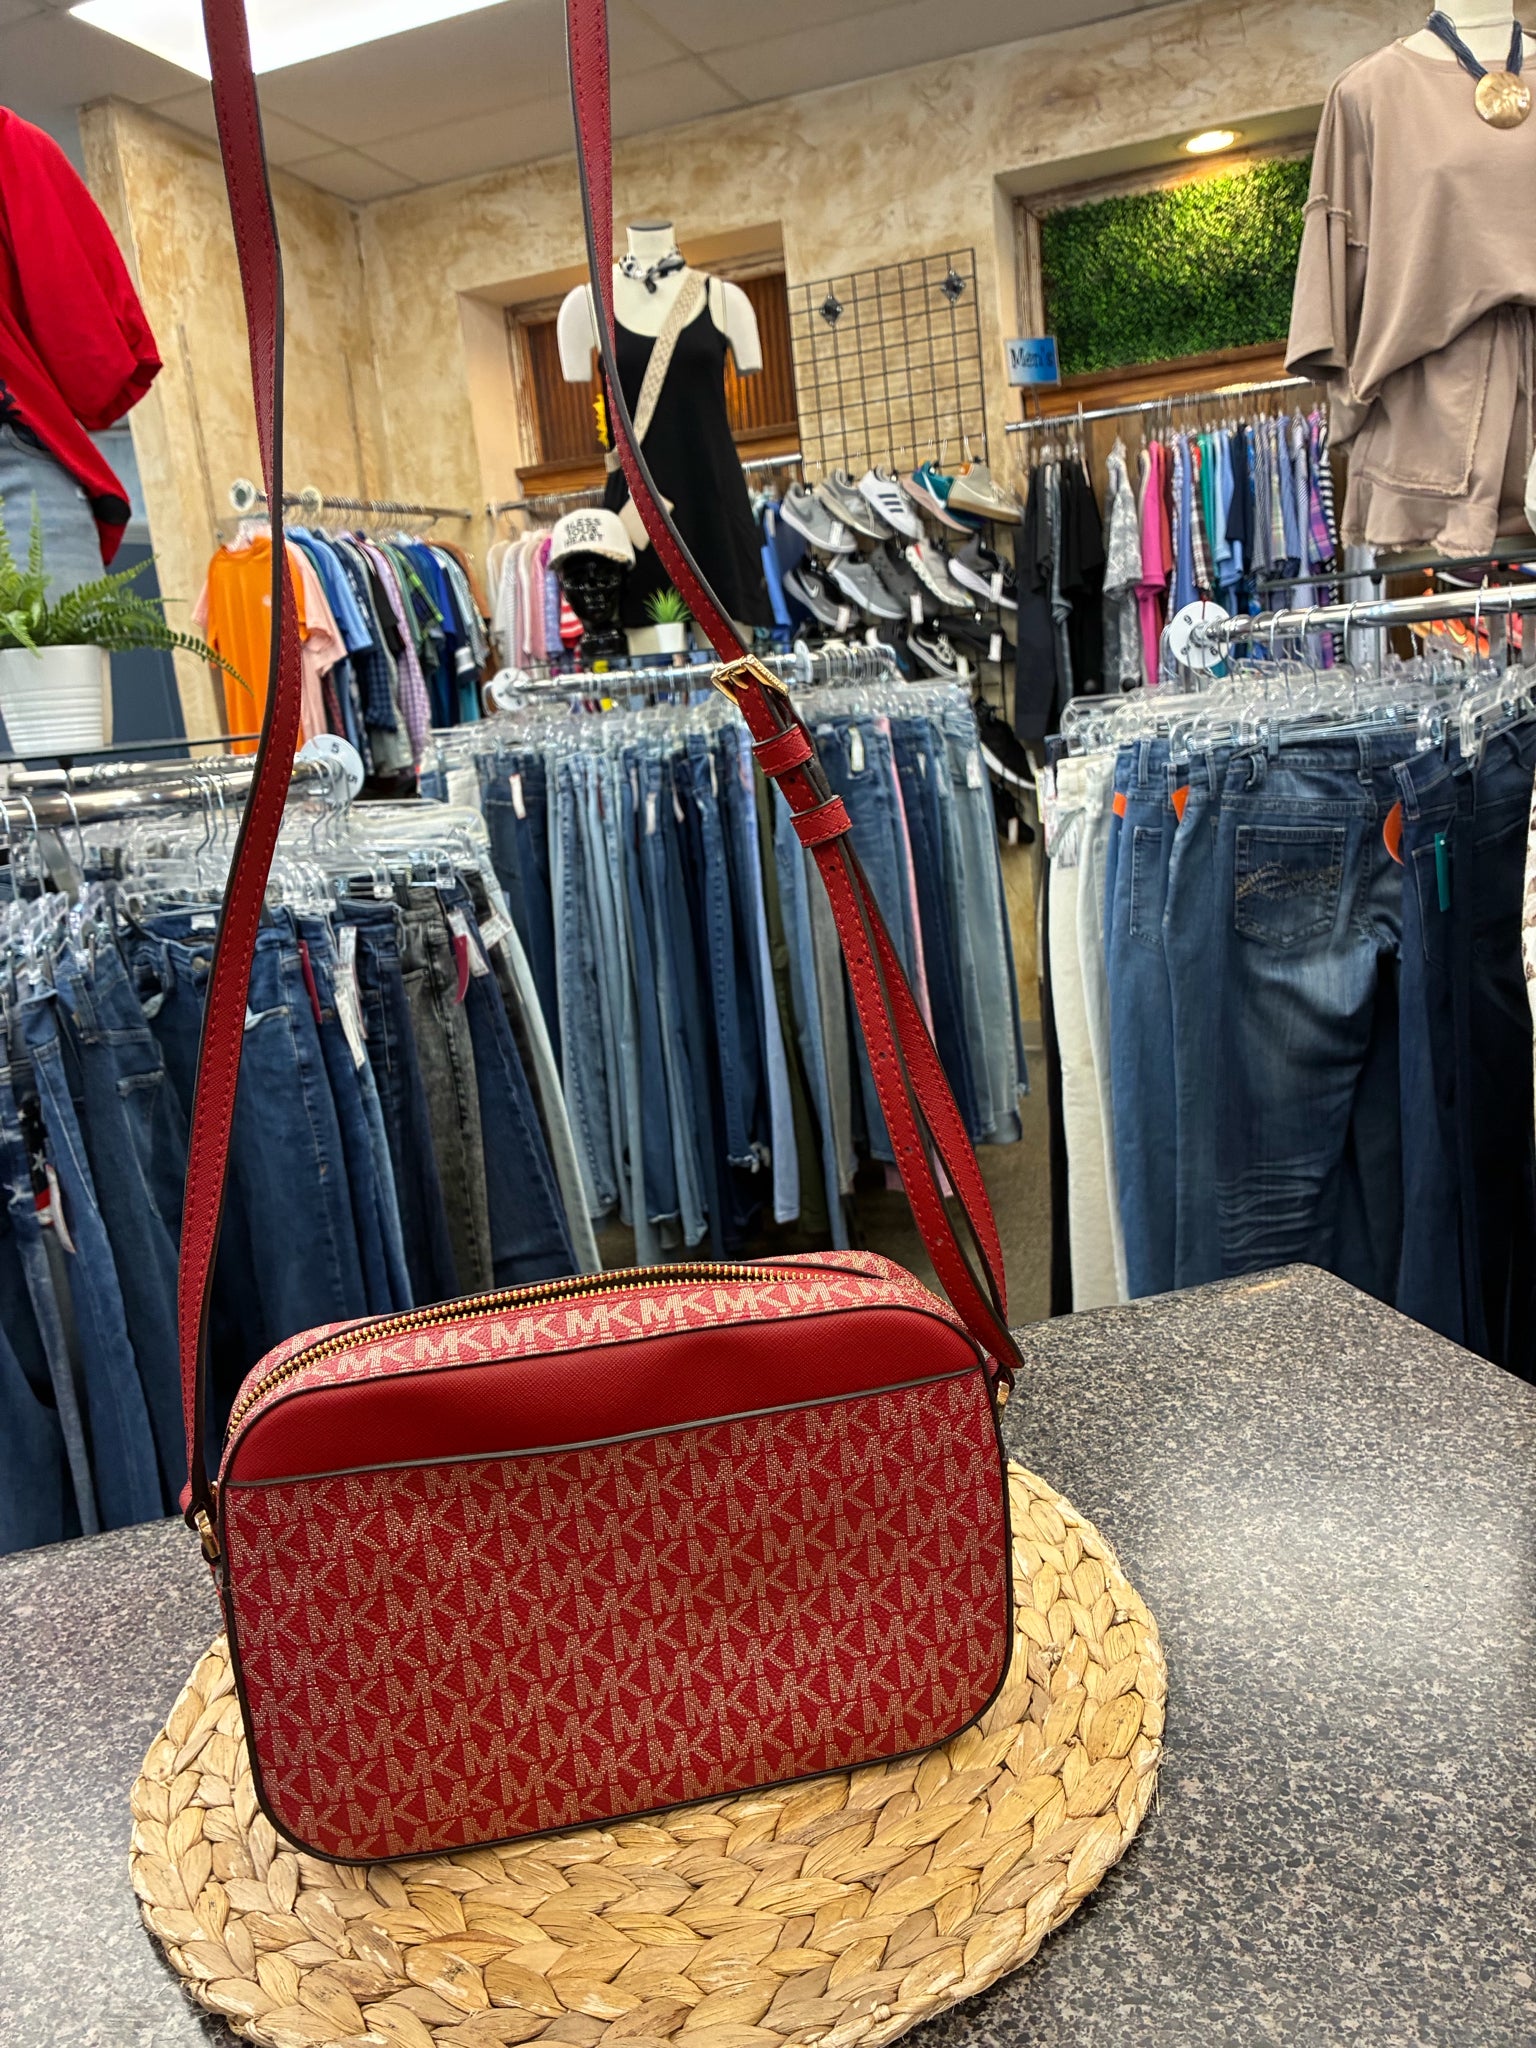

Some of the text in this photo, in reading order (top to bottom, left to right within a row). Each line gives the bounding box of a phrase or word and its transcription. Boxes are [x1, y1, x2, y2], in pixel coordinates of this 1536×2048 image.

[1010, 347, 1054, 369] Men's
[564, 533, 604, 548] HEART
[337, 1341, 410, 1374] MK
[415, 1326, 490, 1361] MK
[491, 1313, 565, 1349] MK
[565, 1300, 640, 1338] MK
[640, 1289, 713, 1325] MK
[713, 1285, 788, 1313] MK
[785, 1281, 856, 1306] MK
